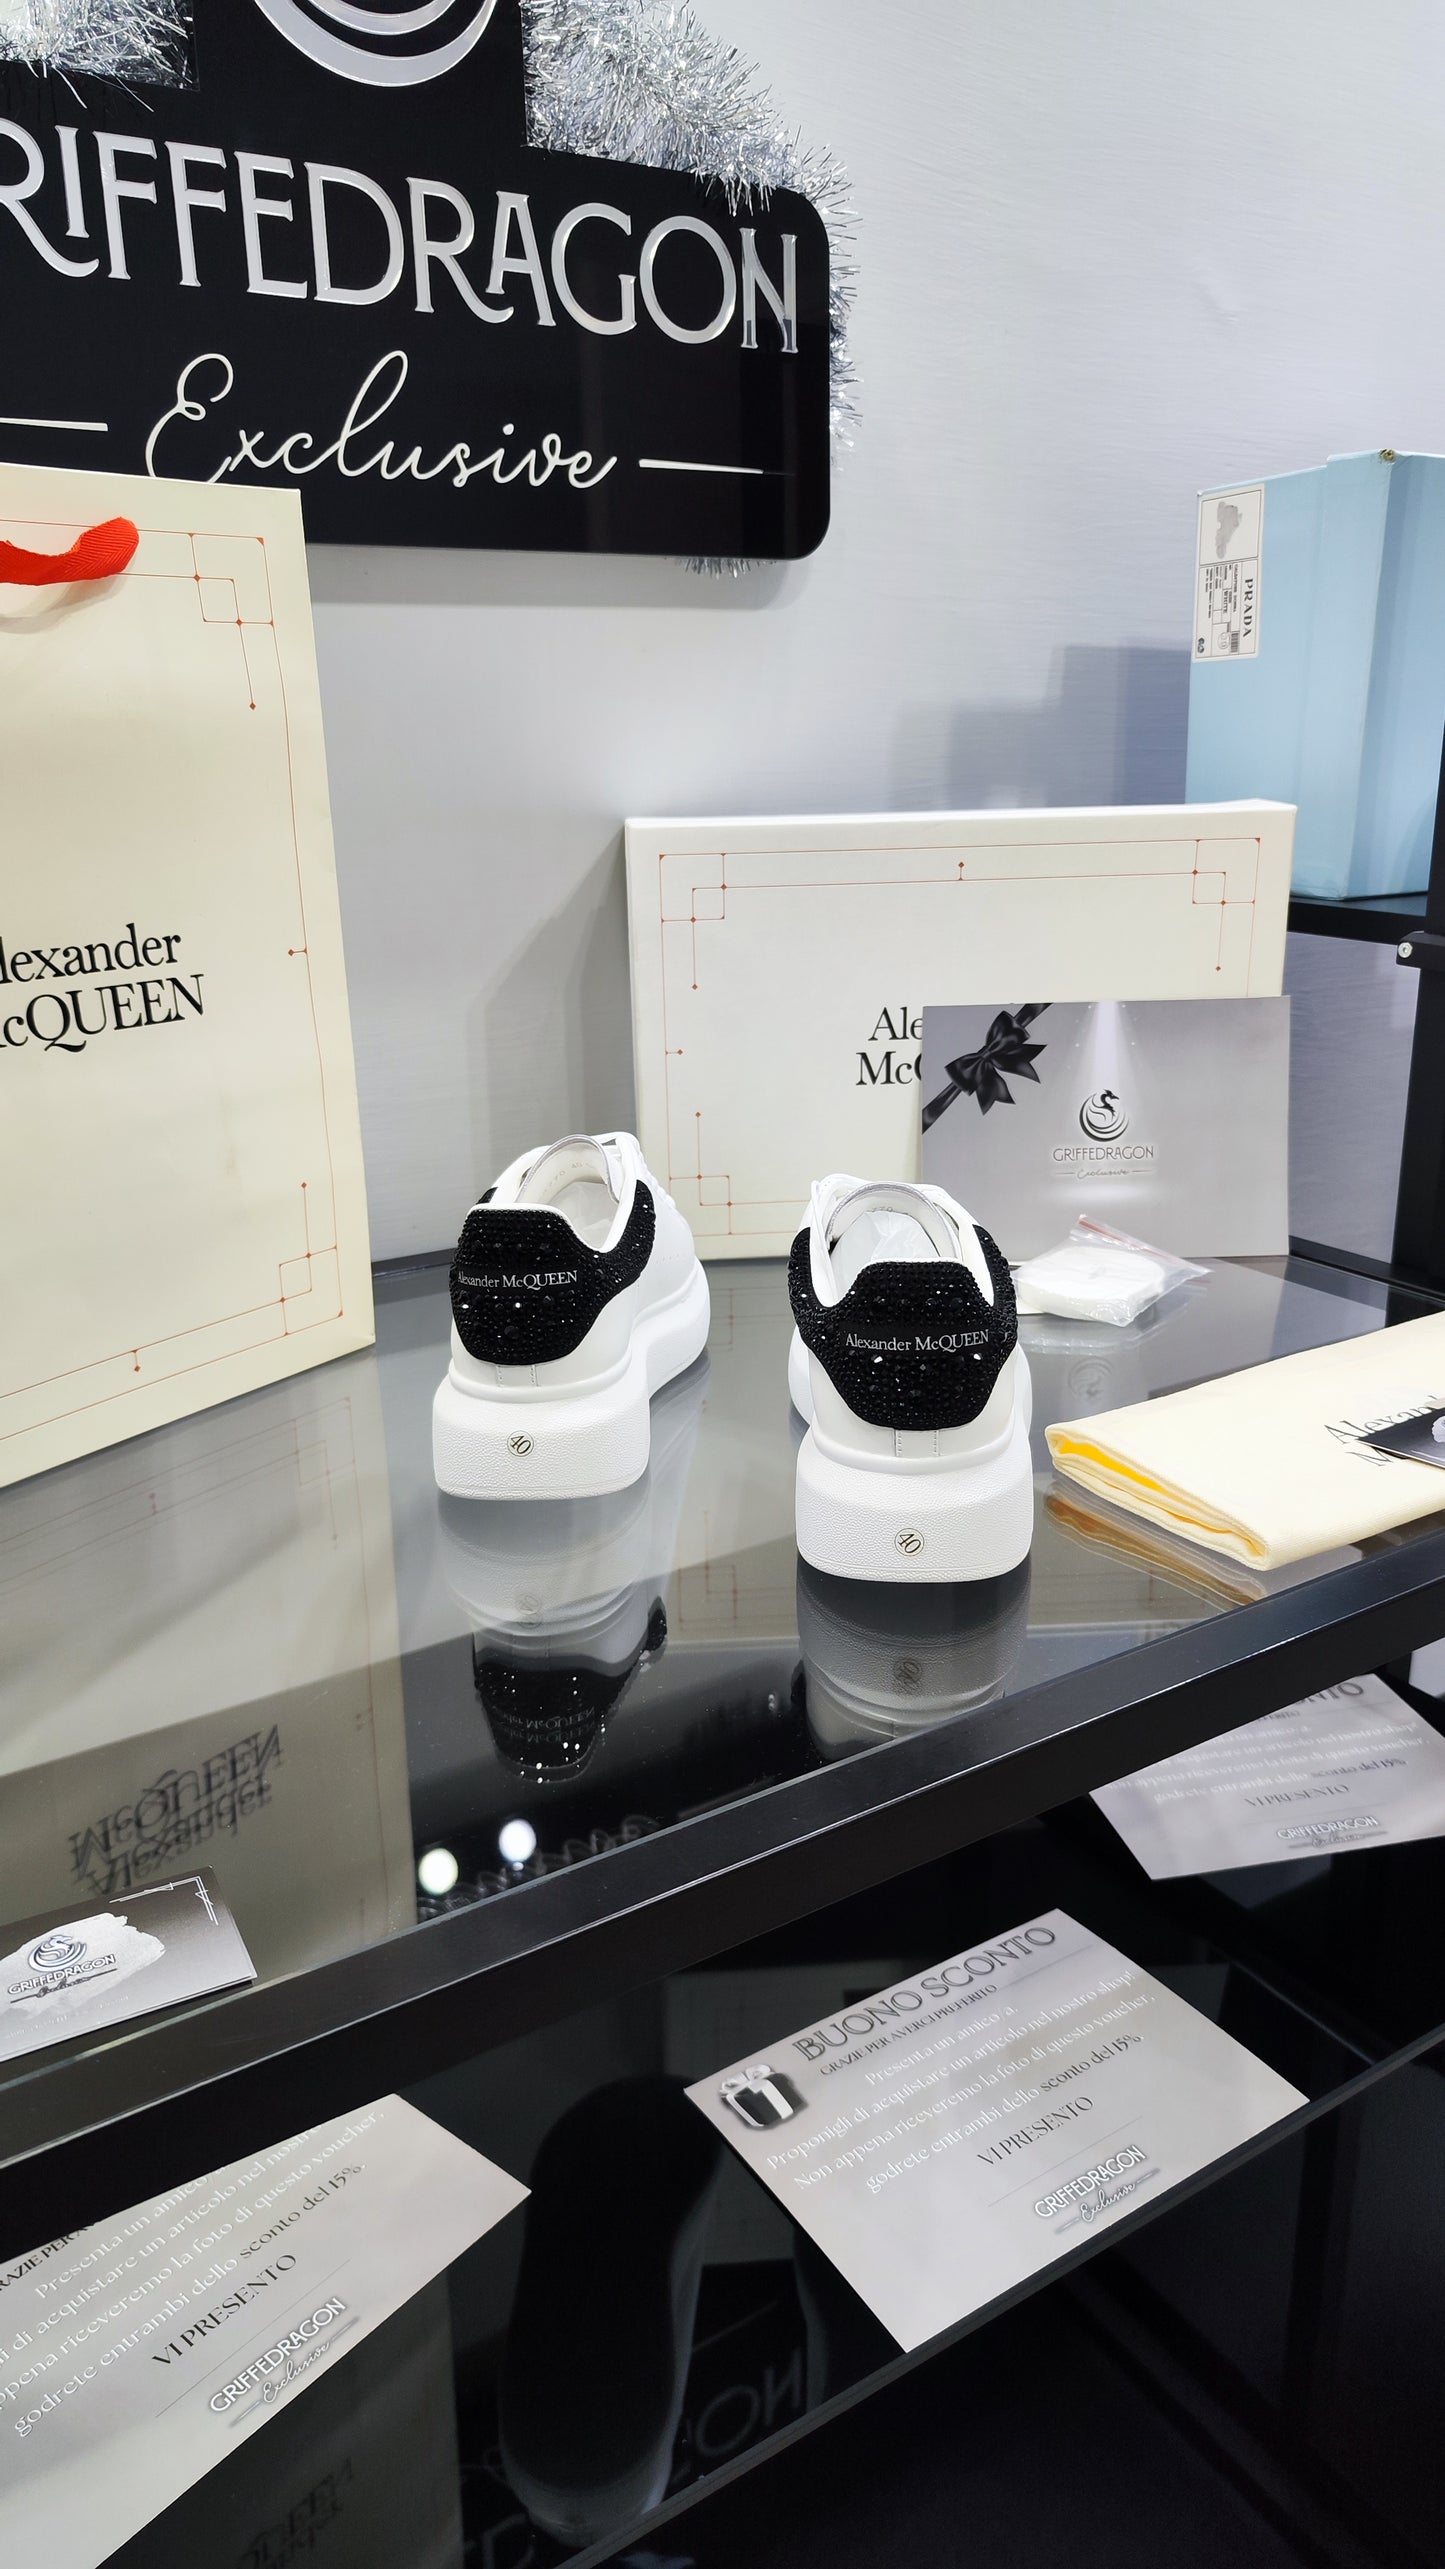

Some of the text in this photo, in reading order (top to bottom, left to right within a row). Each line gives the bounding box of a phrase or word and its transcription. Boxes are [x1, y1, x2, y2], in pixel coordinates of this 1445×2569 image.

[146, 351, 617, 489] Exclusive
[1243, 579, 1254, 637] PRADA
[0, 974, 204, 1053] cQUEEN
[856, 1051, 922, 1085] Mc
[1053, 1145, 1154, 1162] GRIFFEDRAGON
[458, 1269, 578, 1291] Alexander McQUEEN
[846, 1329, 989, 1353] Alexander McQUEEN
[510, 1436, 532, 1454] 40
[897, 1534, 921, 1553] 40
[1277, 1816, 1379, 1840] GRIFFEDRAGON
[8, 1954, 117, 1995] GRIFFEDRAGON
[792, 1927, 1056, 2061] BUONO SCONTO
[766, 2114, 853, 2170] Proponigli
[854, 2106, 870, 2122] di
[872, 2065, 949, 2114] acquistare
[950, 2053, 974, 2072] un
[974, 2023, 1029, 2060] articolo
[1028, 2010, 1053, 2032] nel
[1050, 1990, 1098, 2020] nostro
[820, 2048, 867, 2076] GRAZIE
[865, 2037, 893, 2054] PER
[891, 2015, 935, 2041] AVERCI
[864, 2046, 934, 2086] Presenta
[933, 2035, 957, 2053] un
[794, 2162, 833, 2190] Non
[835, 2128, 896, 2168] appena
[895, 2081, 983, 2135] riceveremo
[979, 2072, 1000, 2088] la
[997, 2056, 1031, 2080] foto
[1030, 2045, 1047, 2062] di
[1046, 2022, 1095, 2054] questo
[865, 2149, 931, 2194] godrete
[930, 2106, 1003, 2153] entrambi
[1002, 2087, 1040, 2114] dello
[1040, 2061, 1092, 2093] sconto
[1090, 2044, 1116, 2065] del
[977, 2096, 1094, 2165] VI PRESENTO
[1034, 2144, 1147, 2218] GRIFFEDRAGON
[1080, 2182, 1136, 2222] Exclusive
[12, 2330, 34, 2351] di
[37, 2256, 138, 2334] acquistare
[139, 2236, 166, 2258] un
[169, 2185, 239, 2239] articolo
[238, 2161, 267, 2187] nel
[34, 2234, 124, 2299] Presenta
[123, 2216, 151, 2237] un
[60, 2267, 173, 2354] riceveremo
[170, 2252, 194, 2269] la
[192, 2223, 233, 2254] foto
[234, 2205, 254, 2225] di
[254, 2163, 313, 2210] questo
[14, 2364, 99, 2438] godrete
[99, 2292, 191, 2366] entrambi
[191, 2259, 239, 2296] dello
[240, 2211, 301, 2259] sconto
[302, 2186, 331, 2212] del
[152, 2254, 297, 2365] VI PRESENTO
[210, 2297, 347, 2412] GRIFFEDRAGON
[263, 2341, 331, 2403] Exclusive
